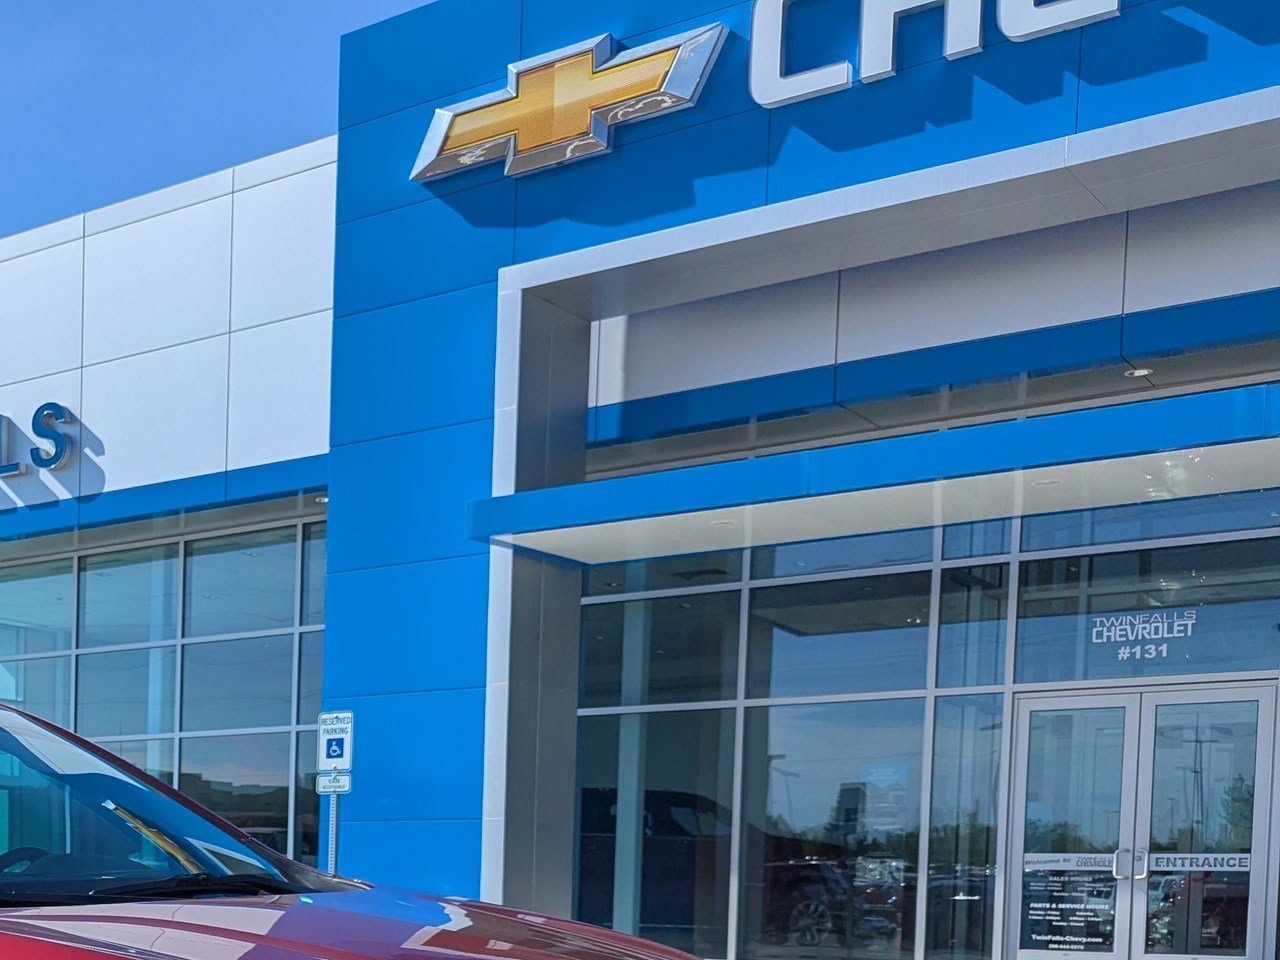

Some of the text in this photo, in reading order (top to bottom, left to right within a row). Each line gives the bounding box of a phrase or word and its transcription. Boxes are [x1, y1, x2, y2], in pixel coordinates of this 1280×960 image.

[1093, 610, 1197, 628] TWINFALLS
[1092, 619, 1196, 643] CHEVROLET
[1117, 643, 1168, 661] #131
[320, 716, 351, 726] RESERVED
[323, 727, 349, 736] PARKING
[1076, 860, 1114, 868] CHEVROLE
[1154, 856, 1249, 868] ENTRANCE
